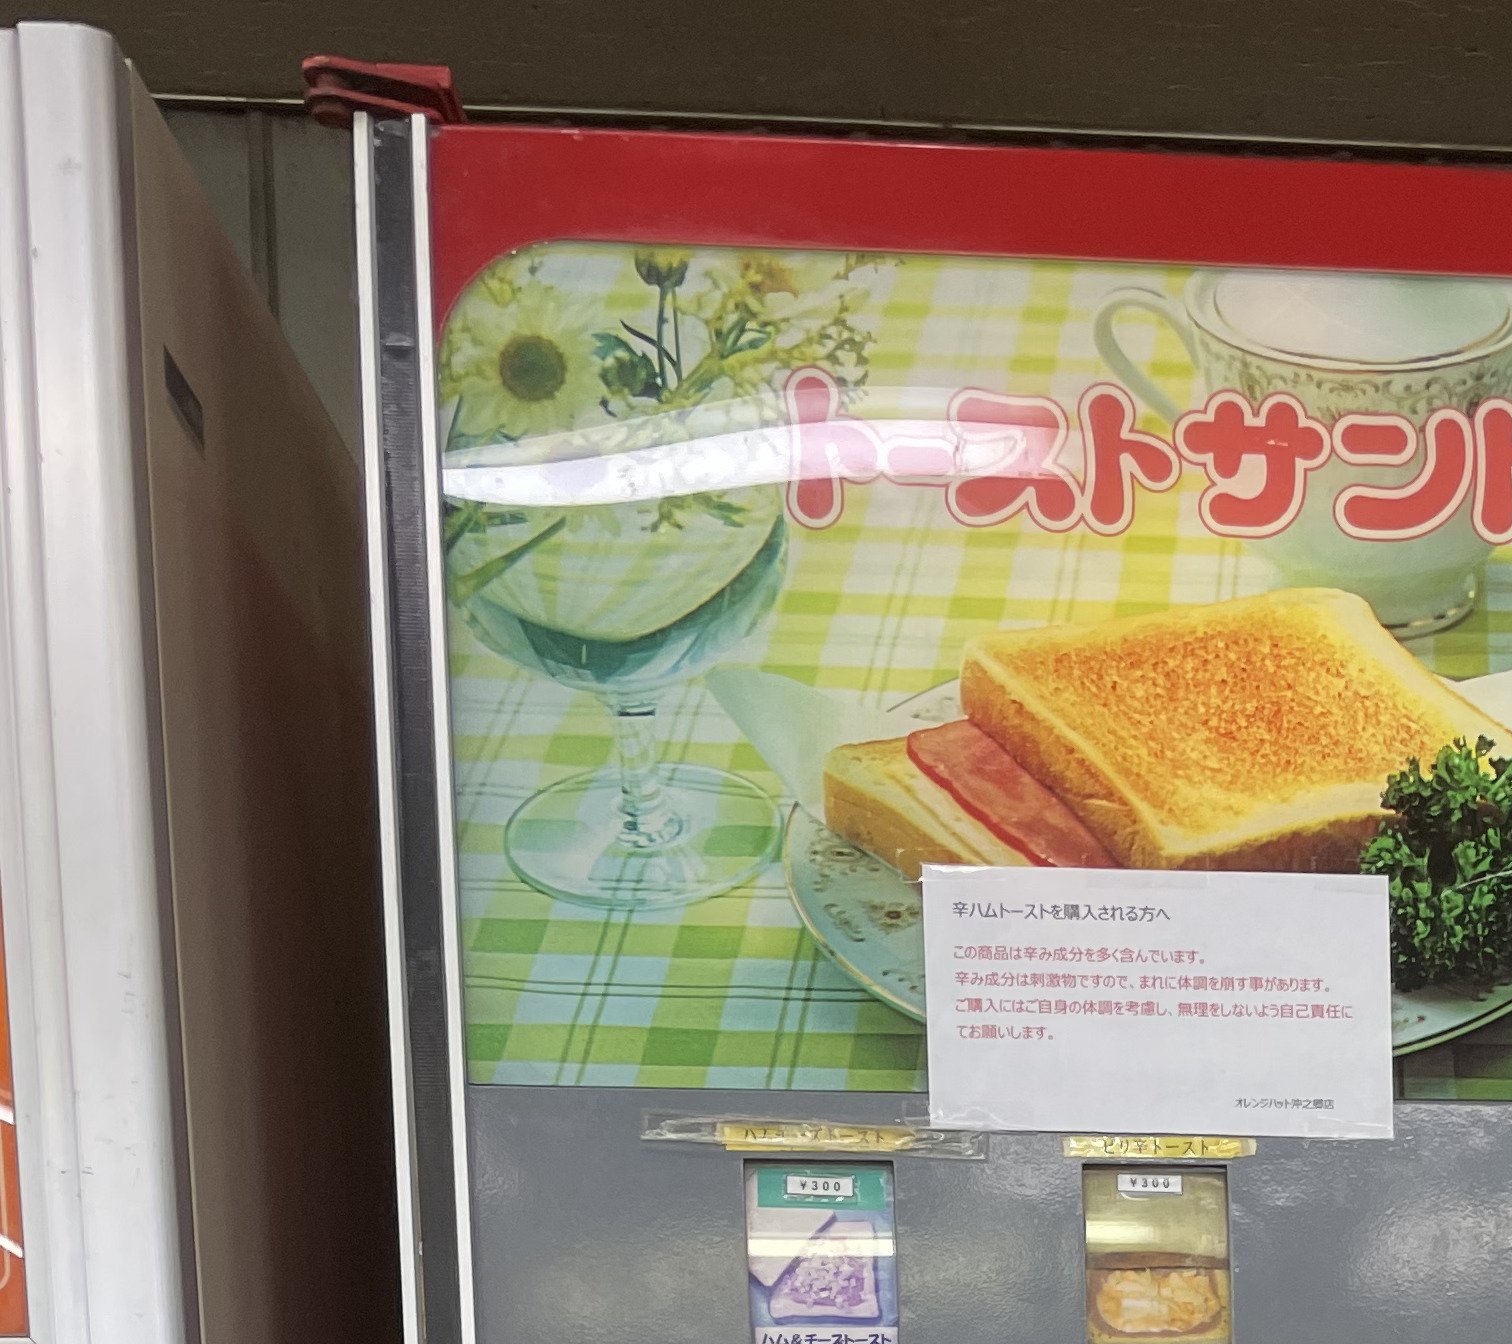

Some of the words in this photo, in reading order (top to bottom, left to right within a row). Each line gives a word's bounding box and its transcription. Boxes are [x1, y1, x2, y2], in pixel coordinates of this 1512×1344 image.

[952, 902, 1171, 922] 辛ハムトーストを購入される方へ
[953, 945, 1205, 964] この商品は辛み成分を多く含んでいます。
[954, 971, 1330, 992] 辛み成分は刺激物ですので、まれに体調を崩す事があります。
[954, 998, 1354, 1019] ご購入にはご自身の体調を考慮し、無理をしないよう自己責任に
[957, 1024, 1055, 1041] てお願いします。
[799, 1179, 841, 1192] ¥300
[1129, 1177, 1170, 1189] ¥300
